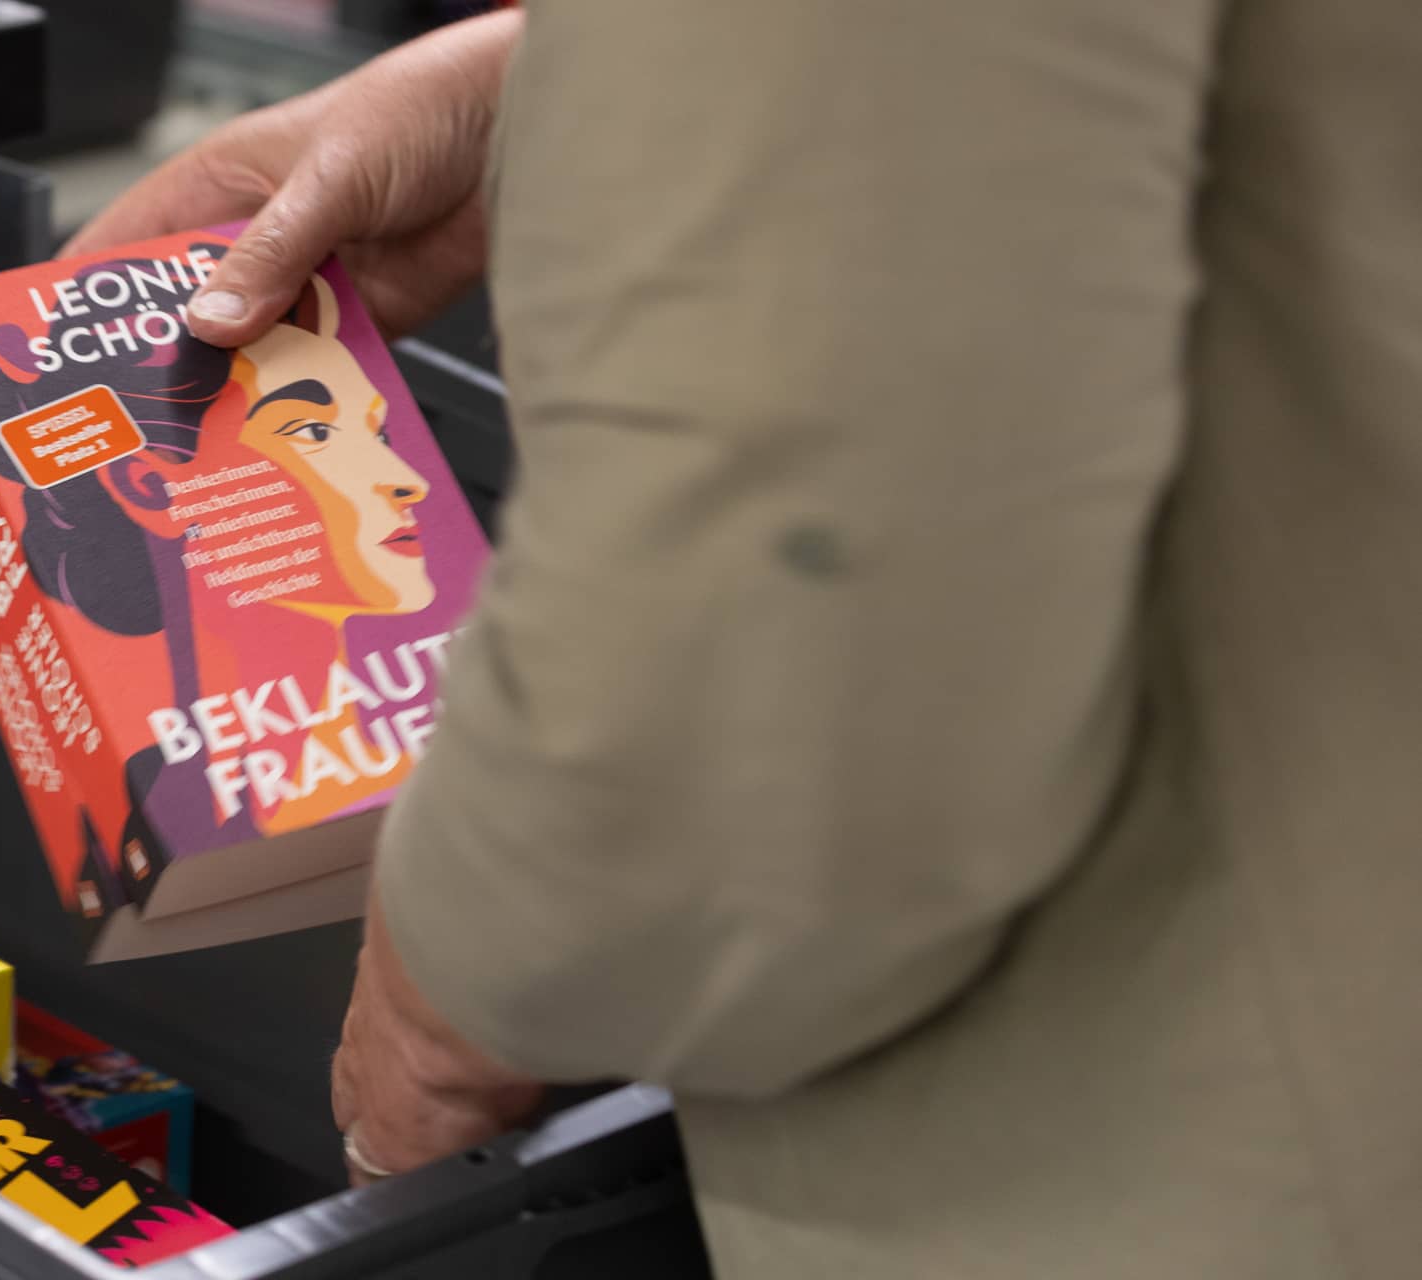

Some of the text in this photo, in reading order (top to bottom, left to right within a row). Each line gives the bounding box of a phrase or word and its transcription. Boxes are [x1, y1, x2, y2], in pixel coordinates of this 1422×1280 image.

[29, 301, 189, 372] SCHÖ
[26, 405, 97, 440] SPIEGEL
[31, 420, 113, 459] Bestseller
[53, 438, 111, 468] Platz 1
[180, 549, 216, 570] Die
[203, 546, 323, 590] Heldinnen der
[227, 572, 323, 609] Geschichte
[146, 627, 460, 766] BEKLAUT
[204, 702, 440, 819] FRAUE
